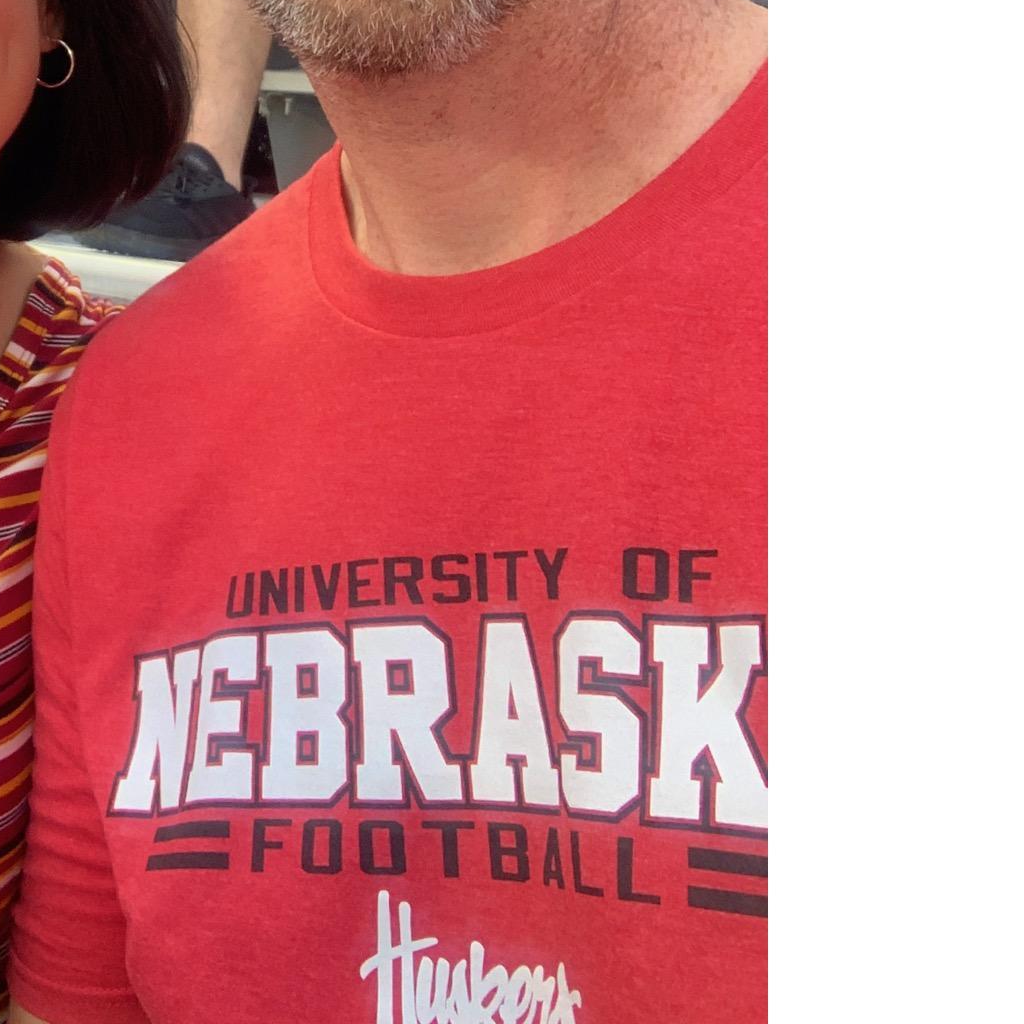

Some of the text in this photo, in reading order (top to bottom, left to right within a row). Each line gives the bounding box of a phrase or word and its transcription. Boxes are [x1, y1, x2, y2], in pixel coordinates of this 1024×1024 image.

[226, 547, 718, 618] UNIVERSITY OF
[106, 610, 768, 839] NEBRASK
[251, 818, 662, 905] FOOTBALL
[360, 889, 582, 1024] Huskers
